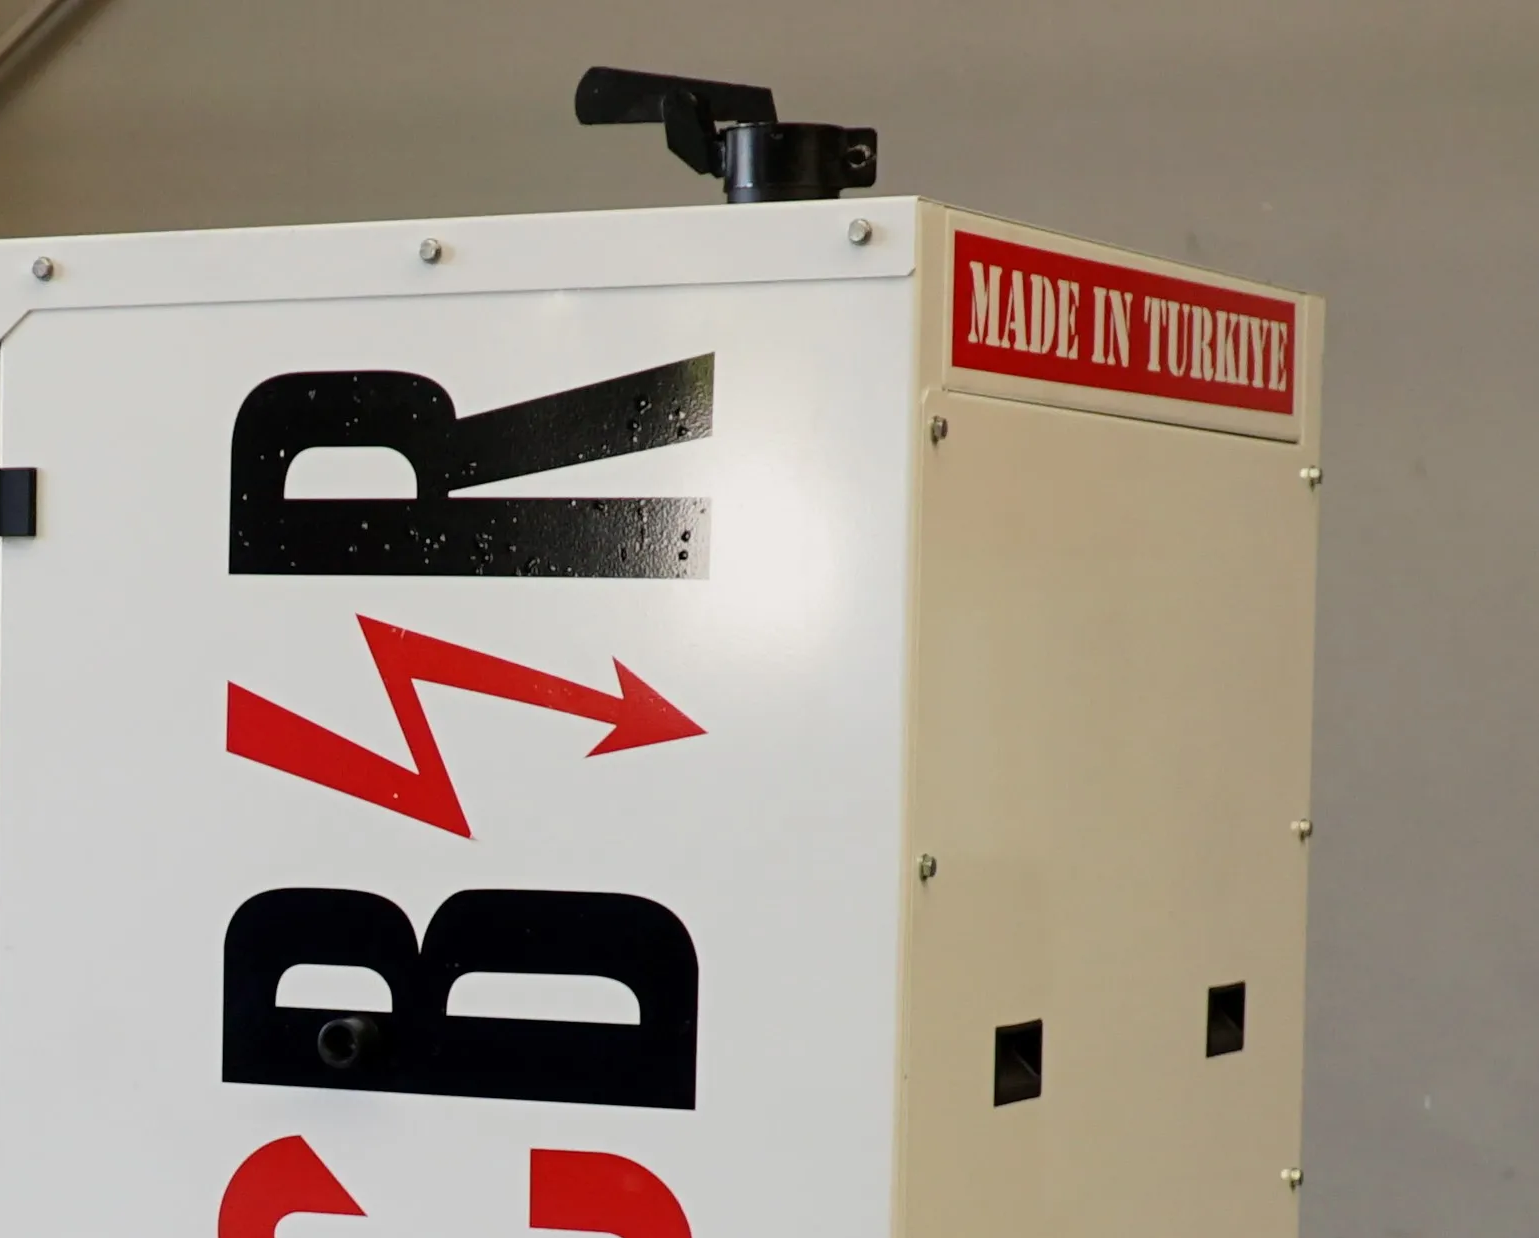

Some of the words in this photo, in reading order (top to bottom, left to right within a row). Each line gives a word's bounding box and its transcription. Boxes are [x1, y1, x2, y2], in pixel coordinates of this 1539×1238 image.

[967, 259, 1080, 361] MADE
[1091, 285, 1134, 368] IN
[1143, 295, 1288, 393] TURKIYE
